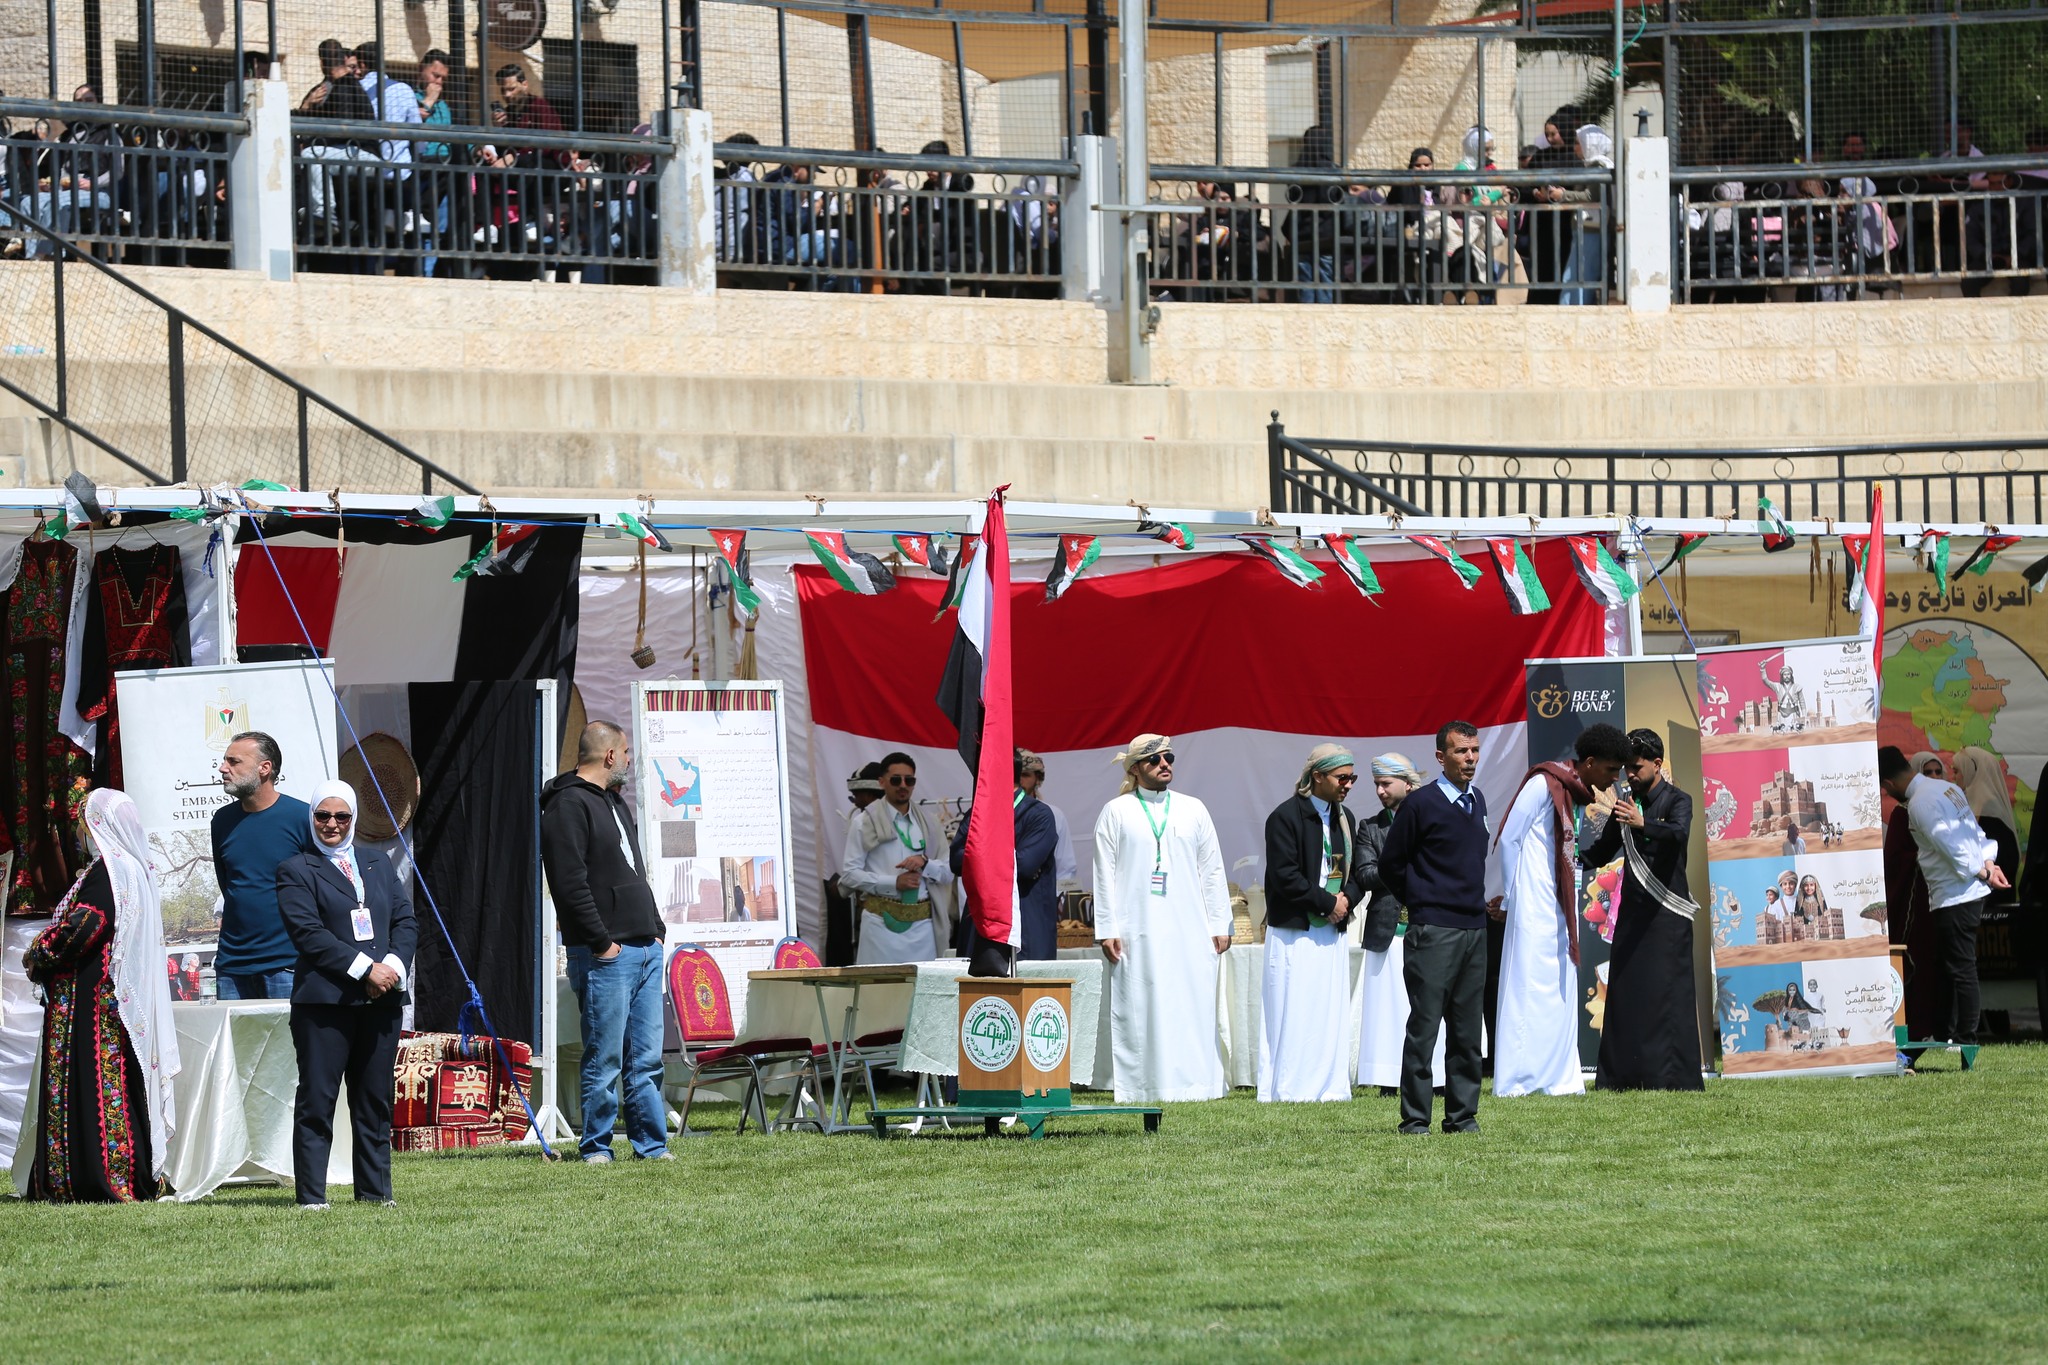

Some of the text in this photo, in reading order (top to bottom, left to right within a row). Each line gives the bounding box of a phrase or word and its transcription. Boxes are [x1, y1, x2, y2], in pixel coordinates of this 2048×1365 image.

[1918, 584, 1966, 614] تاريخ
[1973, 584, 2032, 612] العراق
[1824, 667, 1850, 678] الحضارة
[1572, 690, 1610, 702] BEE &
[1570, 701, 1615, 712] HONEY
[1845, 772, 1860, 780] اليمن
[182, 795, 238, 806] EMBASSY
[173, 810, 208, 820] STATE
[1848, 879, 1864, 887] اليمن
[1844, 985, 1858, 996] في
[1846, 996, 1866, 1005] اليمن
[981, 1059, 1002, 1067] UNIVERSITY
